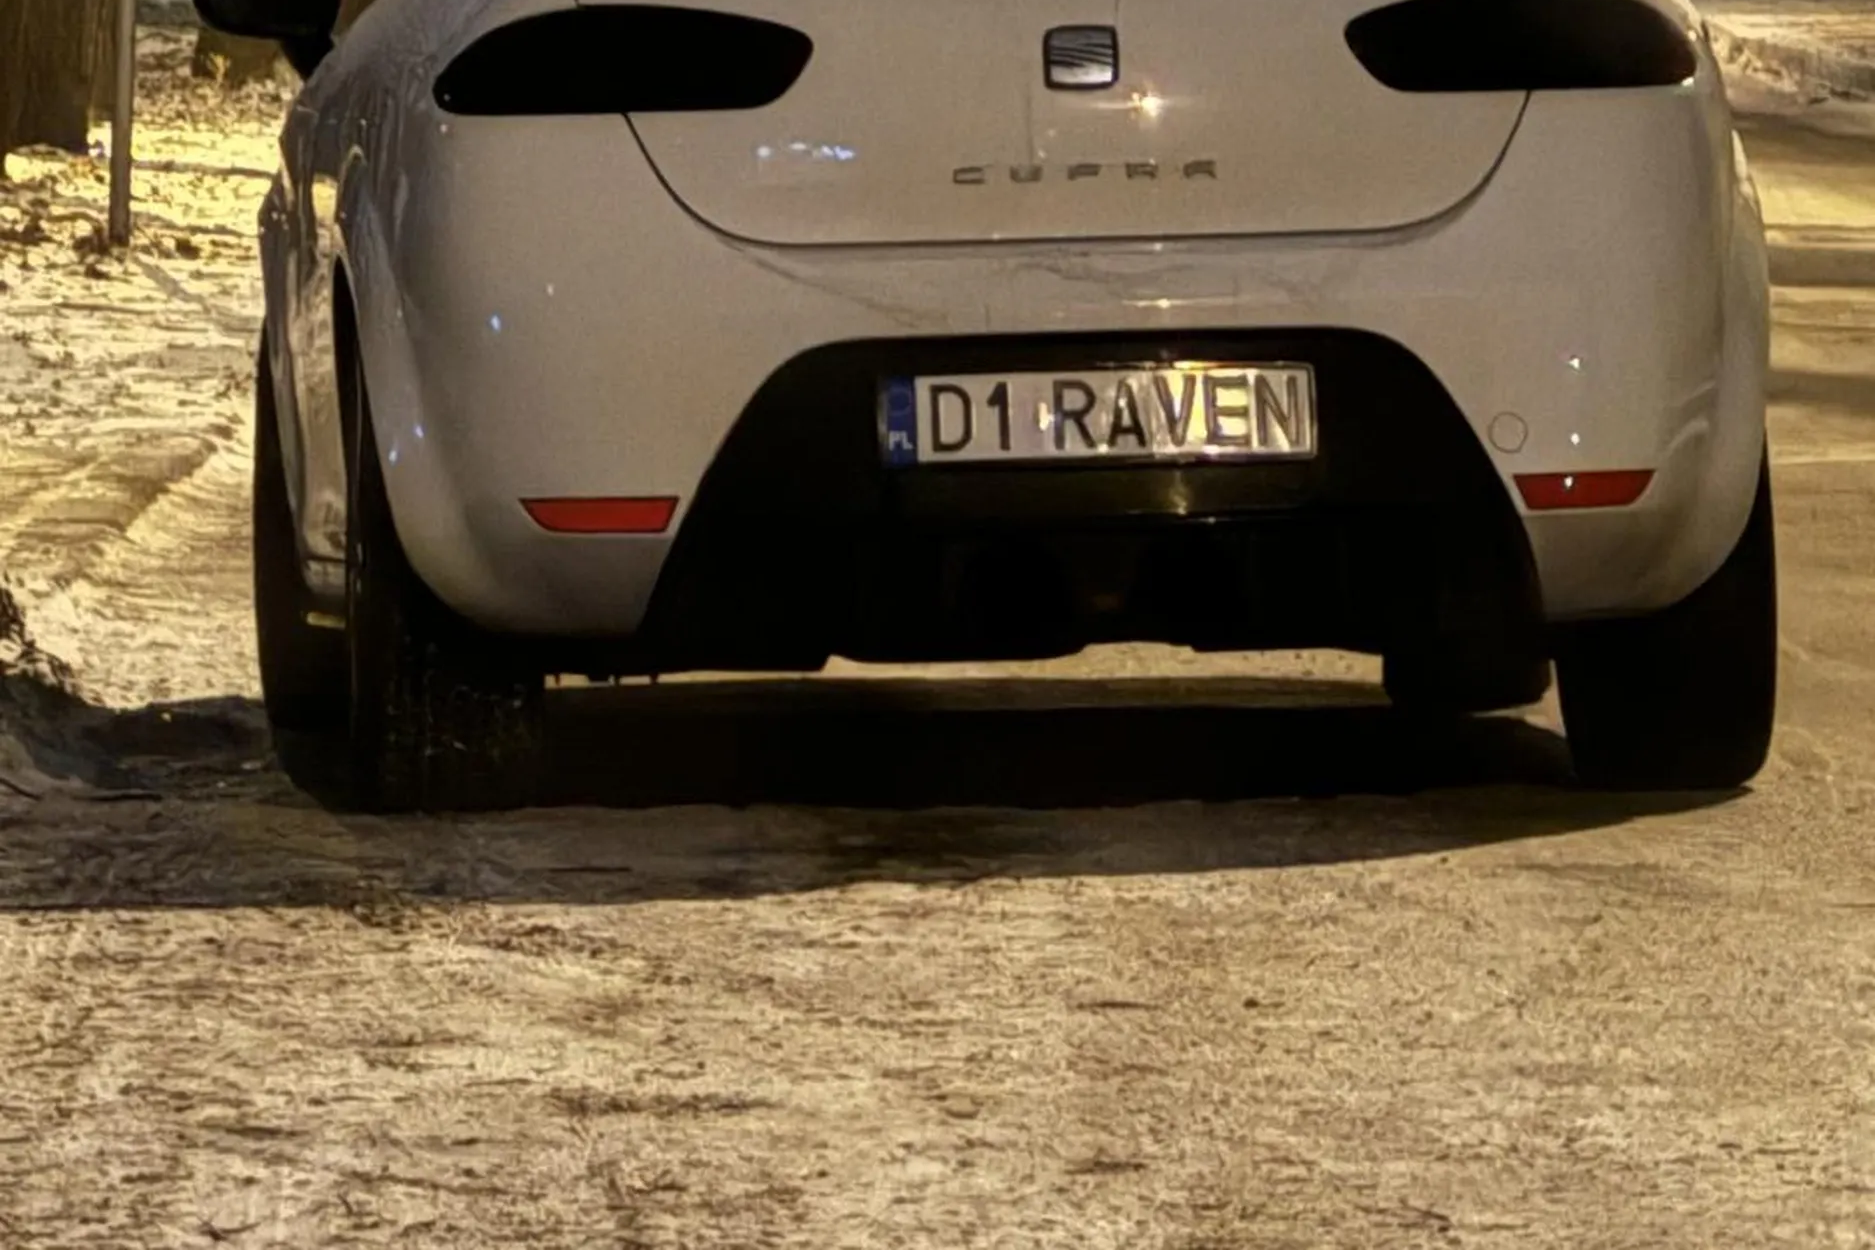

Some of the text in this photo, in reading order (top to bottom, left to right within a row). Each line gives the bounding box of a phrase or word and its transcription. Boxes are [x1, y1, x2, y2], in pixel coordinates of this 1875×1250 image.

[953, 160, 1216, 184] CUPRA
[929, 375, 1299, 452] D1 RAVEN
[888, 430, 913, 451] PL
